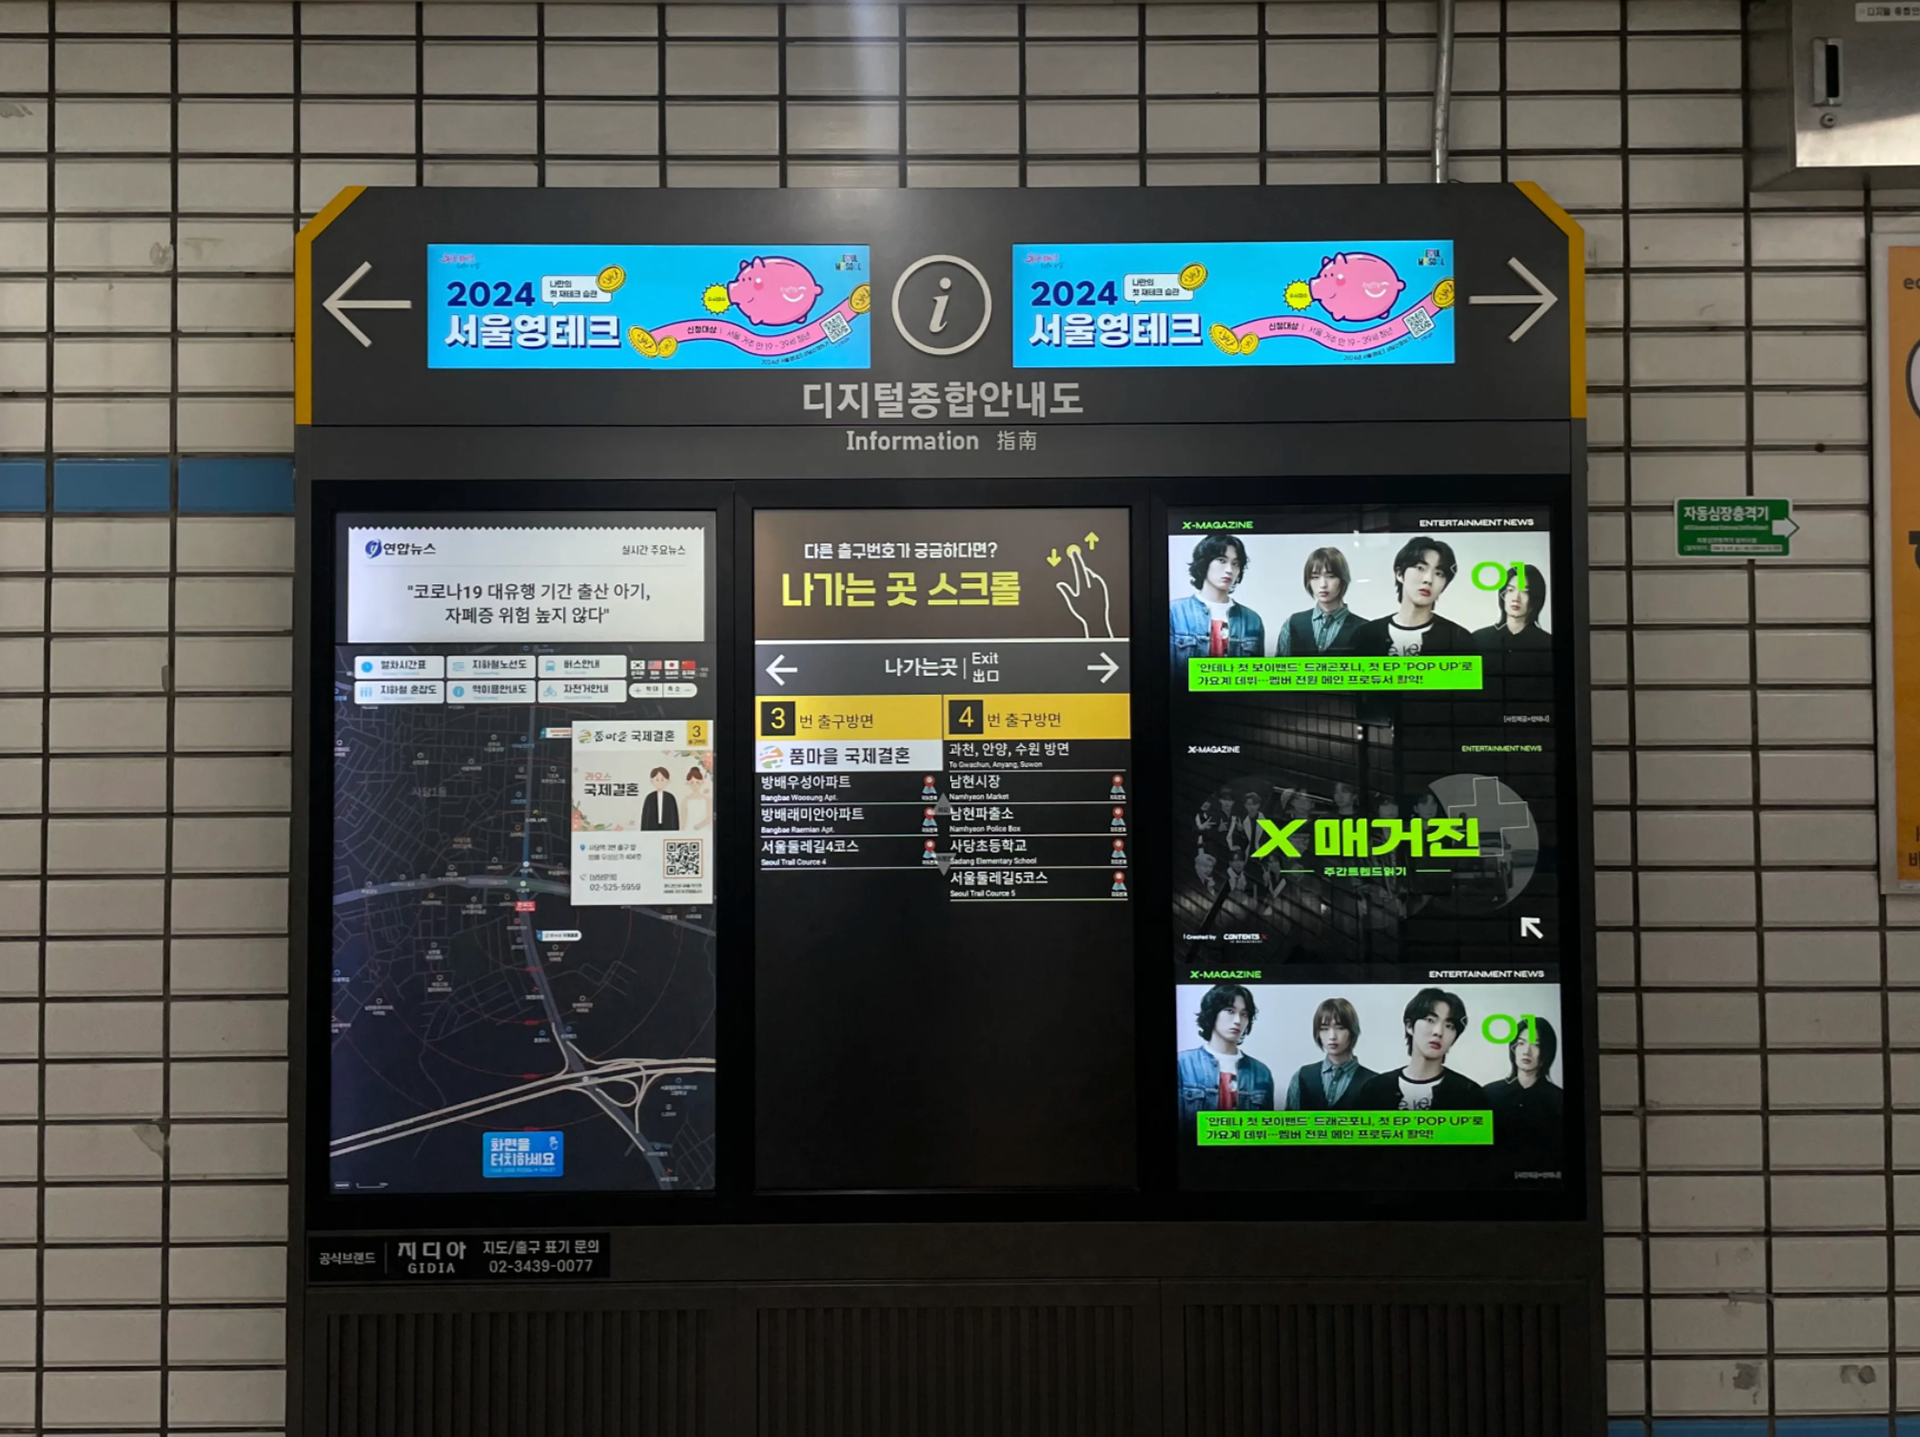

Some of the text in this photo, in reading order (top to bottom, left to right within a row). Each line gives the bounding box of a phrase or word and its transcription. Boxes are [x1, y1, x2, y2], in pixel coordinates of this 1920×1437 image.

[447, 282, 535, 307] 2024
[1031, 281, 1118, 306] 2024
[444, 314, 621, 349] 서울영테크
[1028, 313, 1203, 348] 서울영테크
[803, 381, 1084, 419] 디지털종합안내도
[846, 431, 979, 450] Information
[997, 430, 1037, 450] 指南
[1684, 506, 1768, 521] 자동심장충격기
[1182, 521, 1254, 530] X-MAGAZINE
[1419, 518, 1534, 527] ENTERTAINMENT NEWS
[384, 543, 436, 556] 연합뉴스
[622, 545, 686, 556] 실시간 주요뉴스
[804, 542, 998, 559] 다른 출구번호가 궁금하다면?
[1471, 561, 1527, 592] 01
[407, 584, 651, 601] "코로나19 대유행 기간 출산 아기,
[782, 571, 1020, 607] 나가는 곳 스크롤
[445, 608, 609, 624] 자폐증 위험 높지 않다"
[472, 660, 527, 669] 지하철노선도
[564, 660, 600, 669] 버스안내
[972, 652, 999, 664] Exit
[885, 658, 958, 676] 나가는곳
[1238, 663, 1248, 672] 첫
[1368, 662, 1379, 671] 첫
[1383, 662, 1400, 670] EP
[972, 670, 999, 683] 出口
[1198, 676, 1231, 685] 가요계
[1296, 675, 1318, 685] 전원
[1322, 675, 1344, 685] 메인
[1348, 675, 1393, 684] 프로듀서
[564, 684, 608, 693] 자전거안내
[770, 708, 873, 729] 3 번 출구방면
[958, 706, 1061, 728] 4 번 출구방면
[631, 730, 674, 742] 국제결혼
[692, 726, 700, 737] 3
[790, 747, 910, 765] 품마을 국제결혼
[949, 742, 1069, 757] 과천, 안양, 수원 방면
[1188, 746, 1240, 754] X-MAGAZINE
[585, 772, 611, 781] 라오스
[761, 775, 851, 789] 방배우성아파트
[950, 775, 1000, 788] 남현시장
[584, 783, 639, 796] 국제결혼
[761, 808, 864, 822] 방배래미안아파트
[950, 807, 1014, 820] 남현파출소
[1250, 818, 1480, 858] X 매거진
[761, 840, 859, 854] 서울둘레길4코스
[950, 839, 1027, 853] 사당초등학교
[1324, 866, 1407, 876] 주간트렌드읽기
[950, 871, 1048, 885] 서울둘레길5코스
[1190, 970, 1262, 978] X-MAGAZINE
[1429, 970, 1513, 978] ENTERTAINMENT
[1481, 1013, 1538, 1044] 01
[1247, 1116, 1258, 1126] 첫
[1378, 1116, 1389, 1126] 첫
[1393, 1116, 1410, 1125] EP
[1206, 1130, 1240, 1140] 가요계
[1305, 1130, 1328, 1139] 전원
[1331, 1130, 1354, 1140] 메인
[1358, 1129, 1403, 1139] 프로듀서
[491, 1138, 531, 1151] 화면을
[491, 1152, 555, 1166] 터치하세요
[483, 1240, 599, 1255] 지도/출구 표기 문의
[320, 1252, 376, 1265] 공식브랜드
[408, 1263, 456, 1274] GIDIA
[489, 1260, 592, 1273] 02-3439-0077
